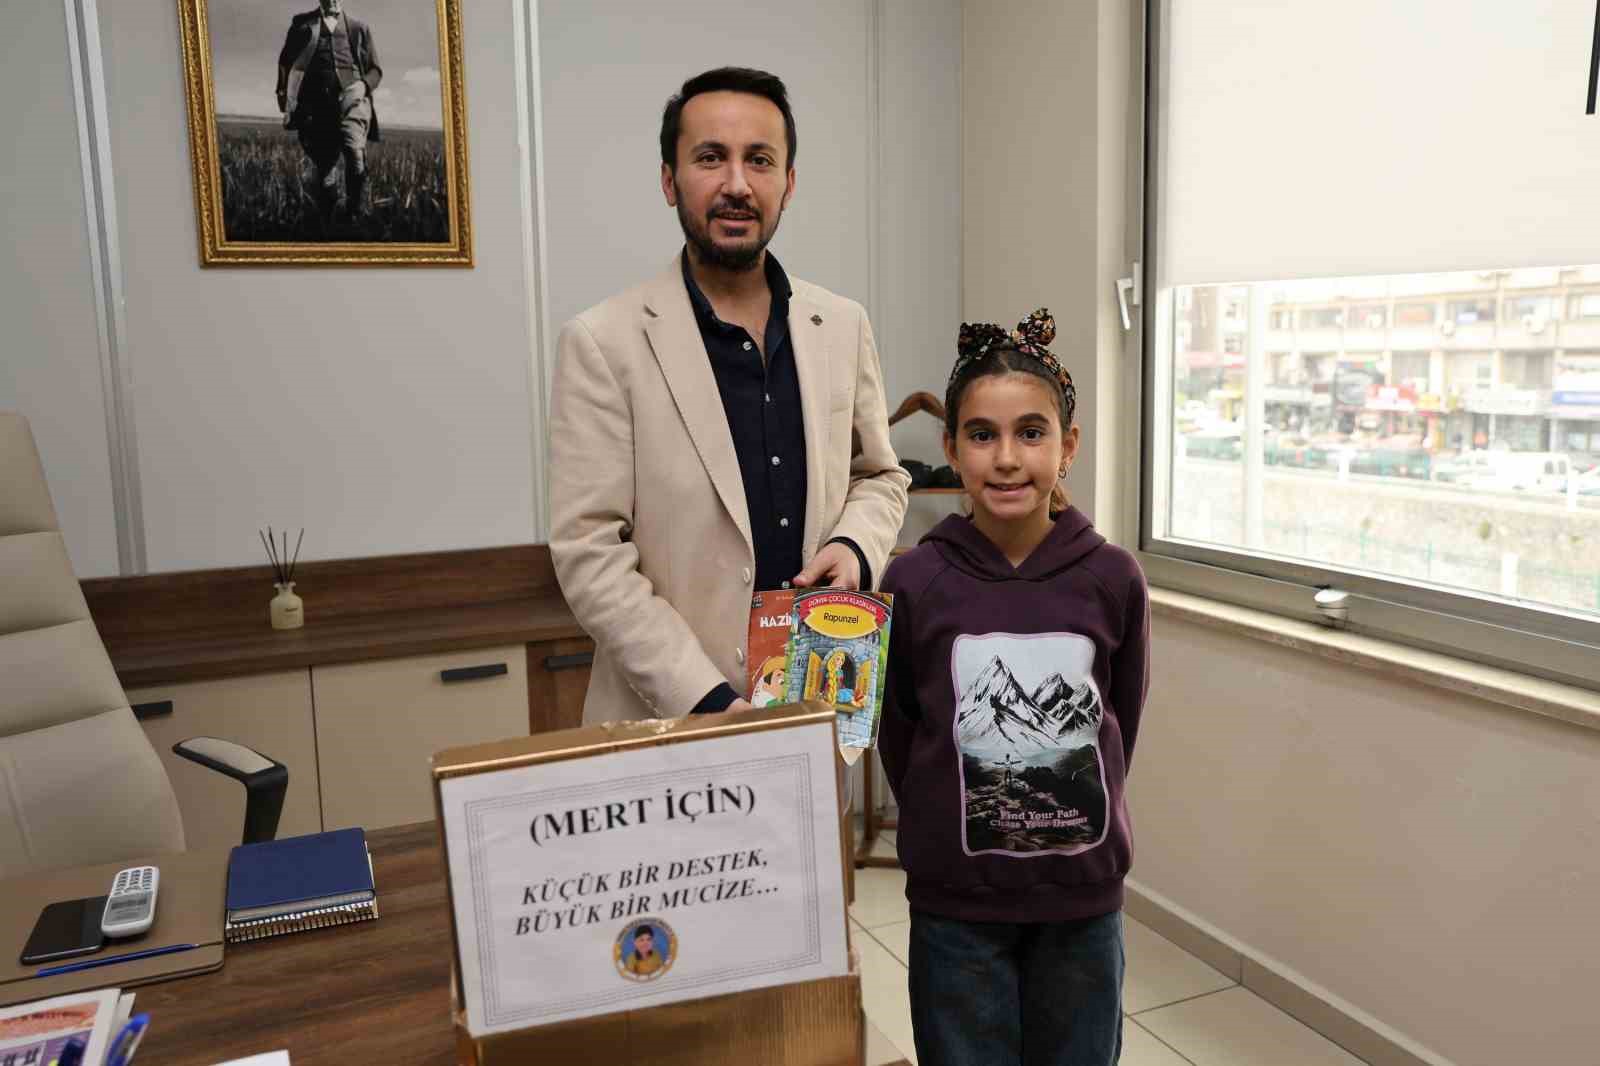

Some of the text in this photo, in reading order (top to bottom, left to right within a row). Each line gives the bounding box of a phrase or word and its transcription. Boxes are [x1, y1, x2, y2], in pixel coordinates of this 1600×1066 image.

[823, 612, 859, 625] Rapunzel
[529, 783, 755, 847] (MERT İÇİN)
[999, 805, 1080, 820] Find Your Path
[1024, 819, 1051, 829] Your
[522, 849, 769, 905] KÜÇÜK BİR DESTEK,
[515, 903, 603, 936] BÜYÜK
[610, 893, 651, 920] BİR
